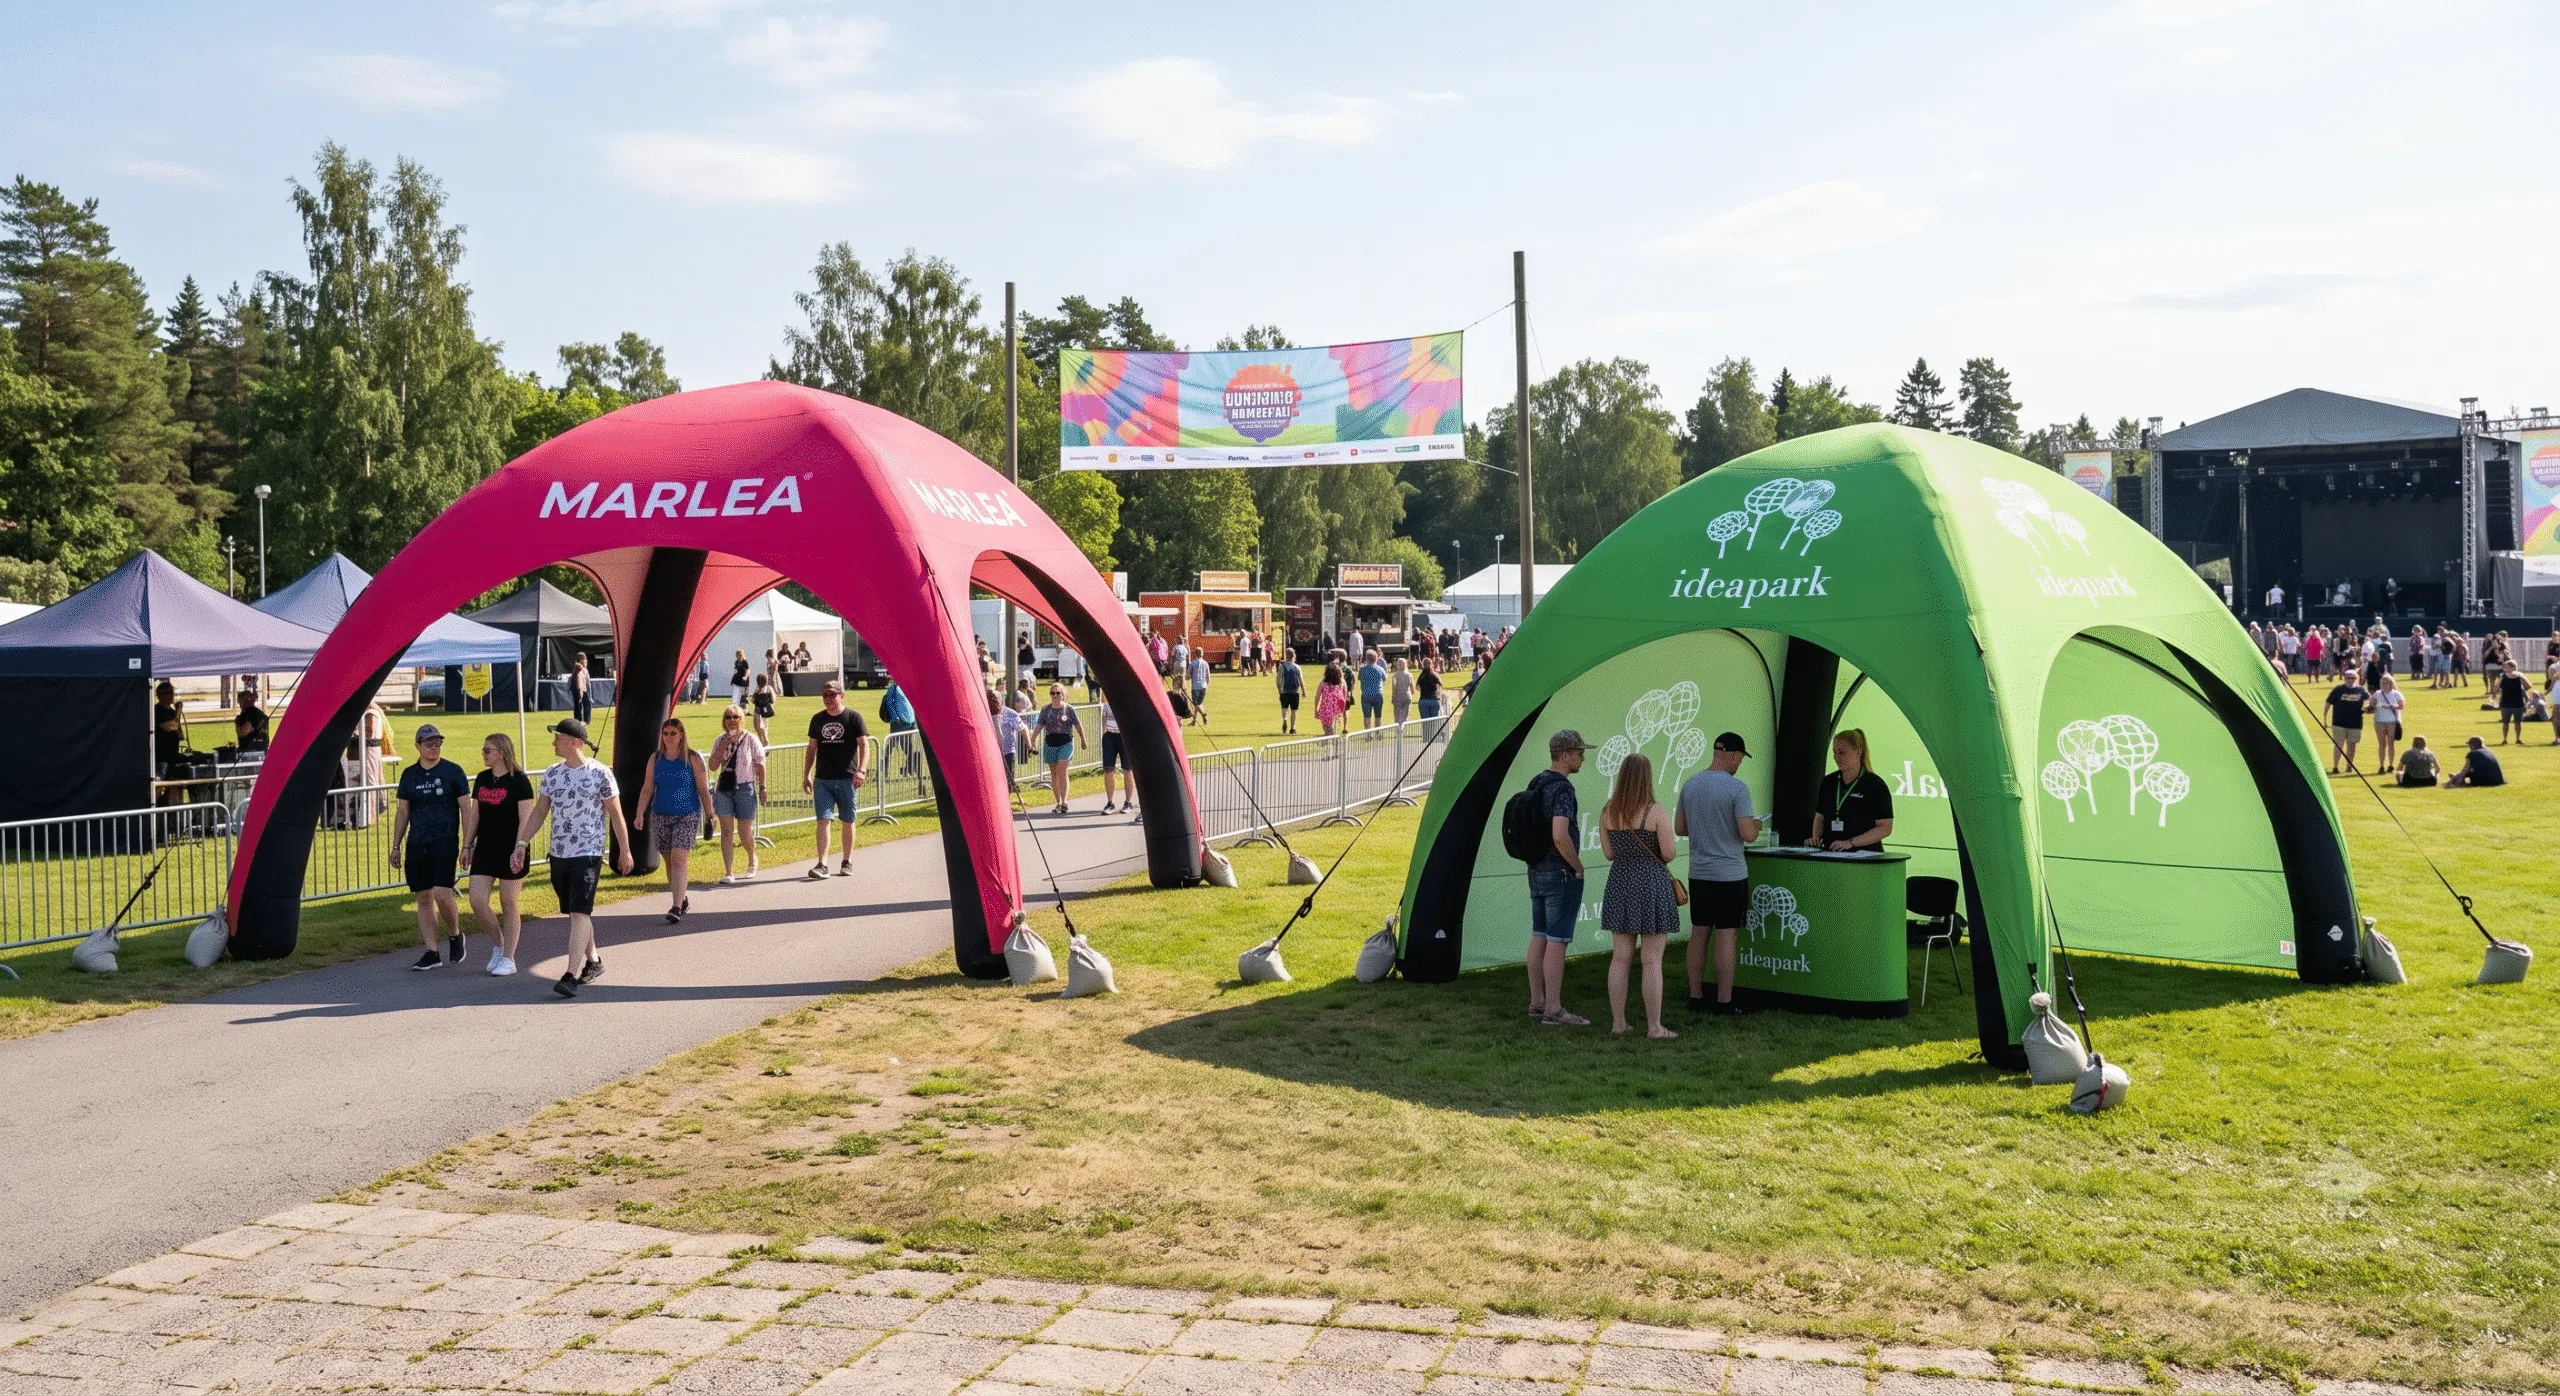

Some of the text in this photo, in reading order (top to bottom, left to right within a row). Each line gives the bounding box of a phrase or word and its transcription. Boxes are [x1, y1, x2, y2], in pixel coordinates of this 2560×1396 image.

[539, 475, 803, 519] MARLEA
[907, 477, 1028, 528] MARLEA
[1669, 565, 1832, 609] ideapark
[2027, 564, 2138, 608] ideapark
[1739, 947, 1812, 975] ideapark
